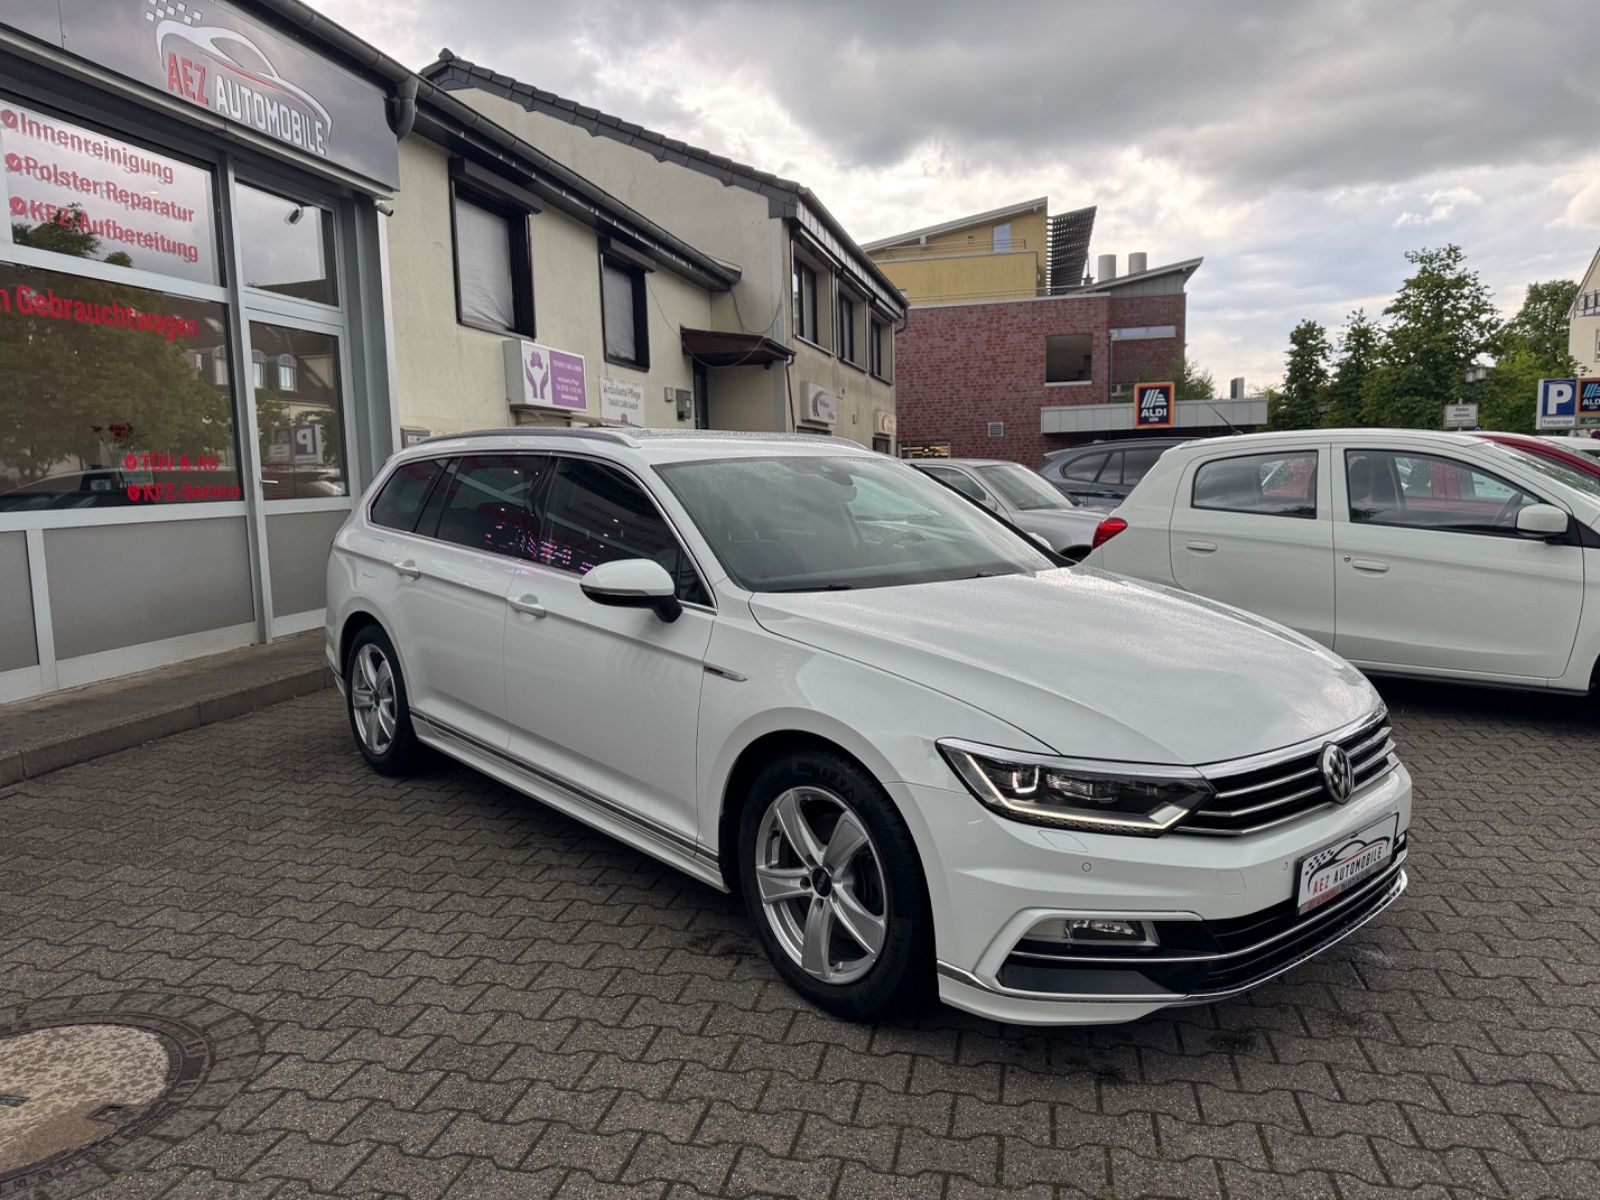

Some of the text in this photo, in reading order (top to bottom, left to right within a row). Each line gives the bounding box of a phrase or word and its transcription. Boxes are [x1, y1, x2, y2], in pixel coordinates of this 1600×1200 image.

[168, 52, 326, 156] AEZ AUTOMOBILE
[20, 113, 173, 185] Innenreinigung
[25, 155, 195, 222] Polster Reparatur
[29, 199, 198, 263] KFZ-Aufbereitung
[16, 285, 199, 341] Gebrauchtwagen
[1141, 408, 1167, 417] ALDI
[1547, 383, 1573, 415] P
[1582, 398, 1600, 406] ALD
[143, 480, 241, 501] KFZ-Service
[1313, 875, 1330, 896] AEZ
[1333, 846, 1383, 884] AUTOMOBILE
